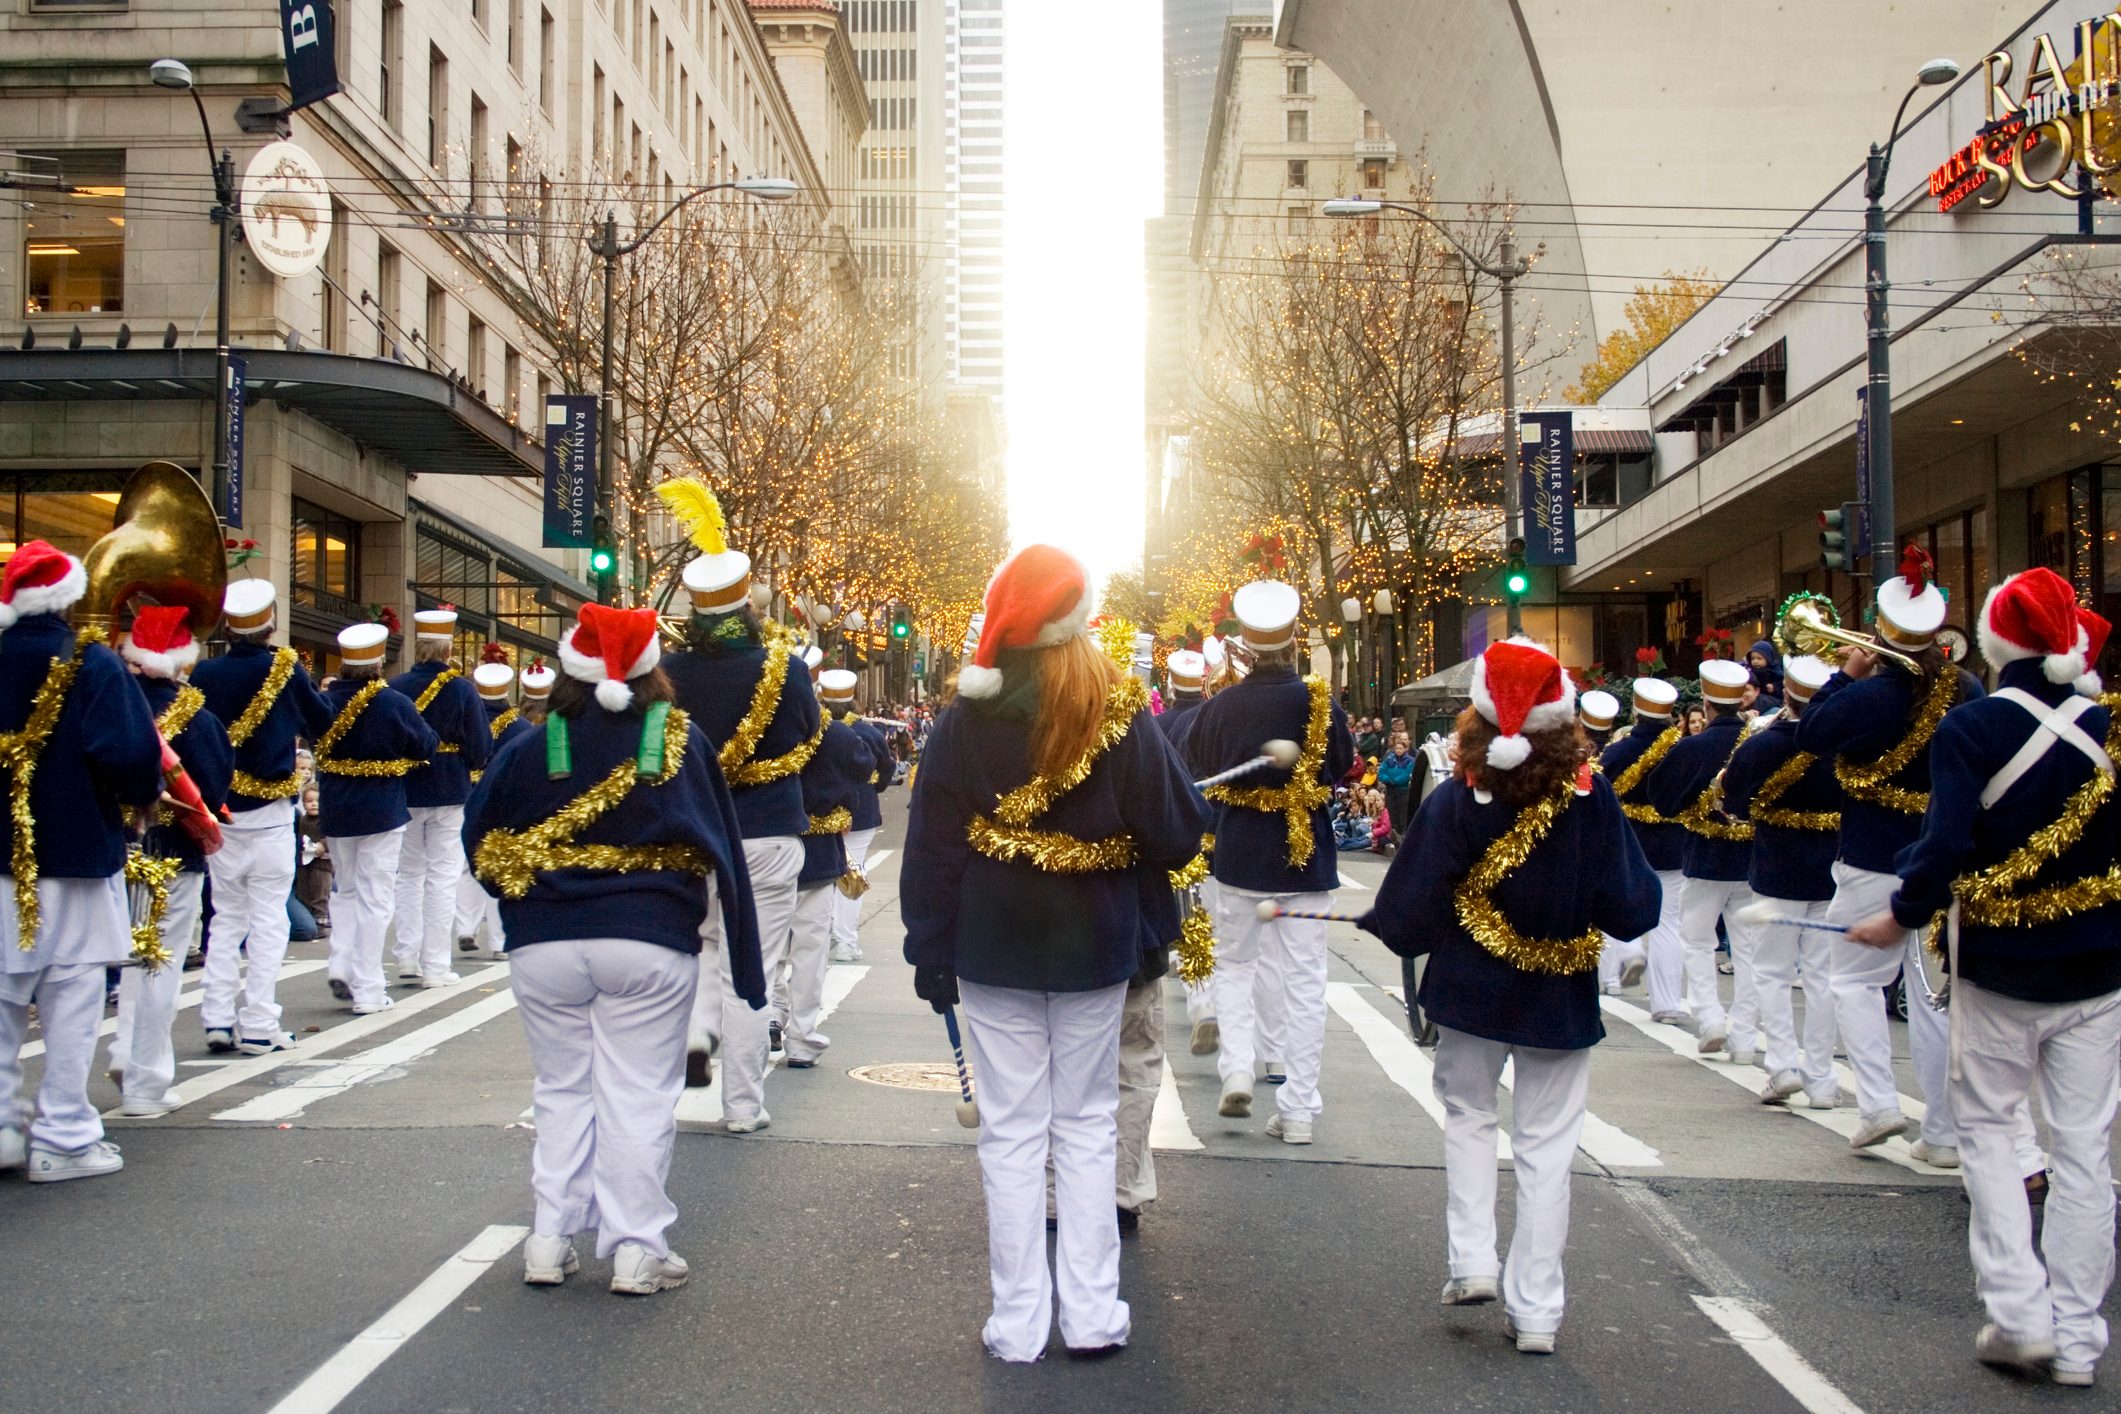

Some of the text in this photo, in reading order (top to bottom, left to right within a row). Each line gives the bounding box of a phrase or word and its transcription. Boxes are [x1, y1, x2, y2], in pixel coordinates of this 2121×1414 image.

[289, 0, 319, 54] B
[1929, 150, 1968, 197] ROCK
[261, 240, 301, 258] ESTABLISHED
[231, 376, 241, 515] RAINIER SQUARE
[552, 430, 577, 517] Upper Fifth
[572, 412, 585, 536] RAINIER SQUARE
[1529, 447, 1556, 533] Upper Fifth
[1550, 429, 1564, 554] RAINIER SQUARE
